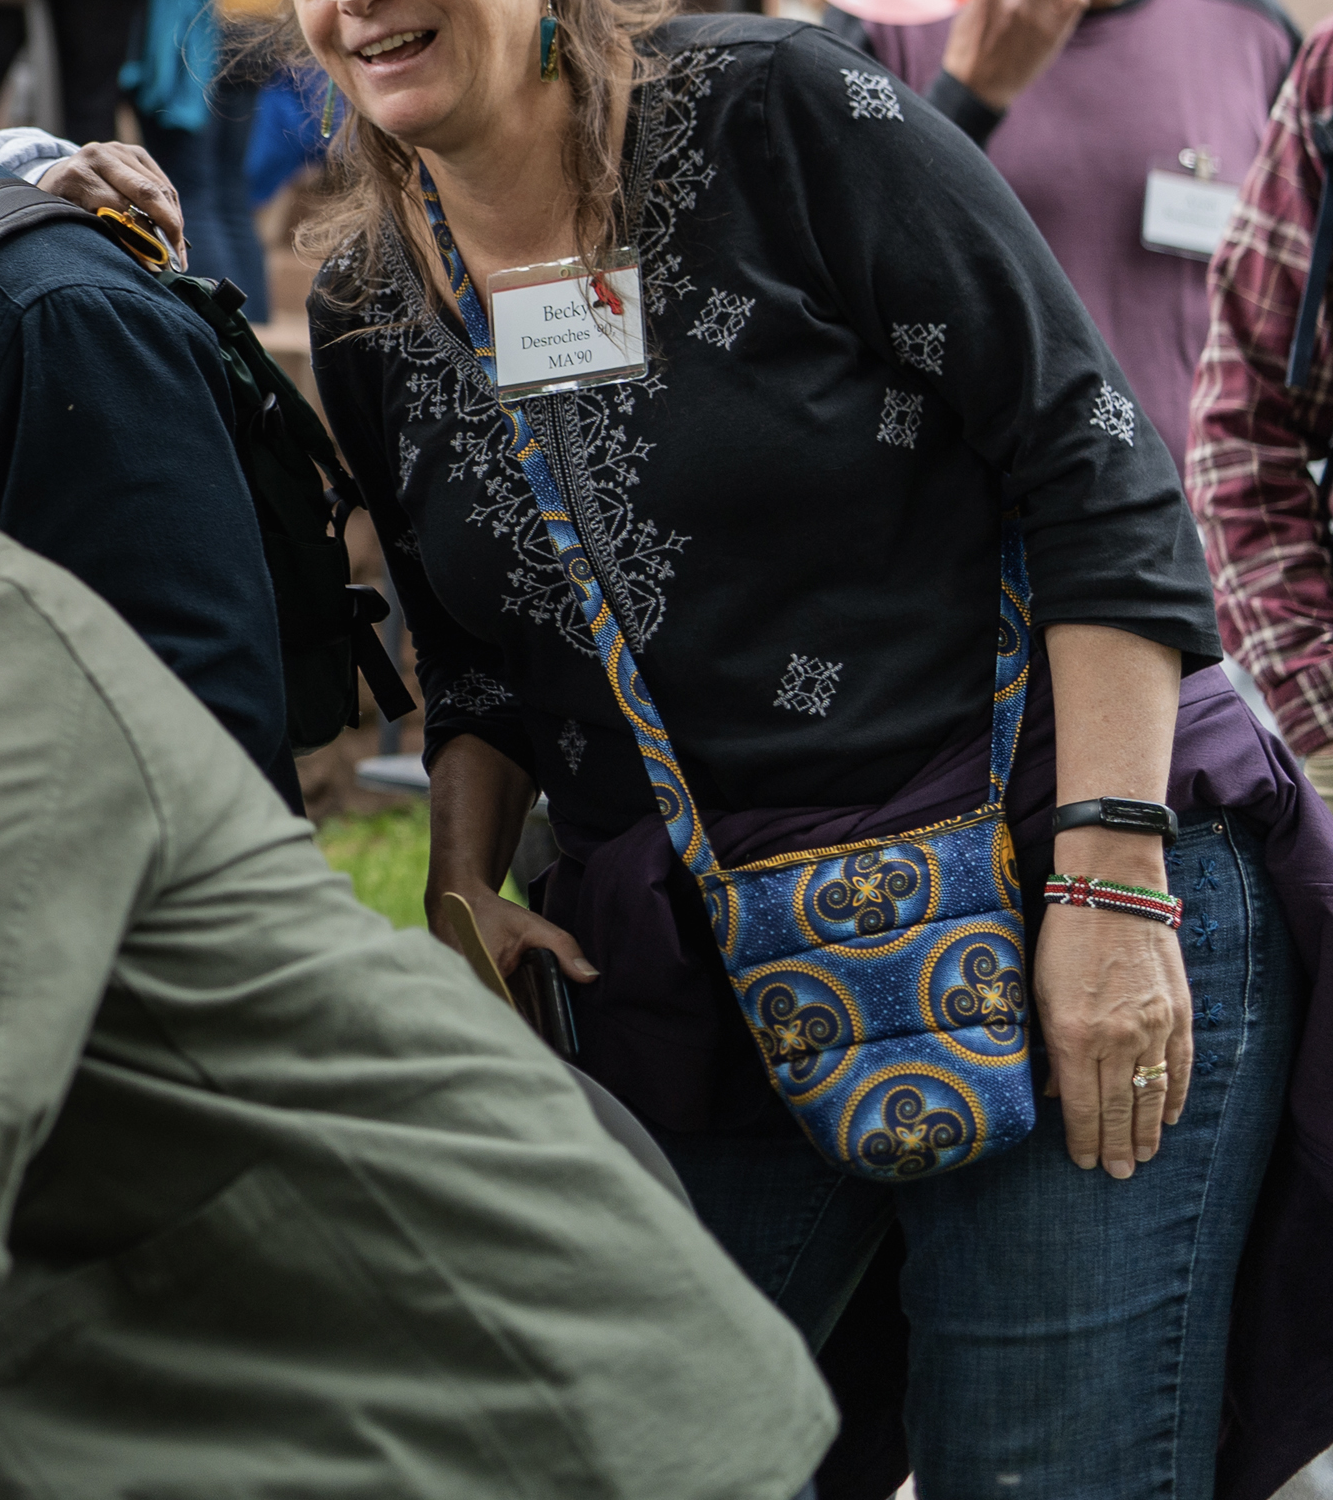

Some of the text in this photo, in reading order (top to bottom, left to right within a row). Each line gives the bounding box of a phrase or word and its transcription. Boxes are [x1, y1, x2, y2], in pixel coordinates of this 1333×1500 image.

[543, 301, 589, 322] Becky
[521, 328, 591, 350] Desroches
[548, 349, 593, 370] MA'90
